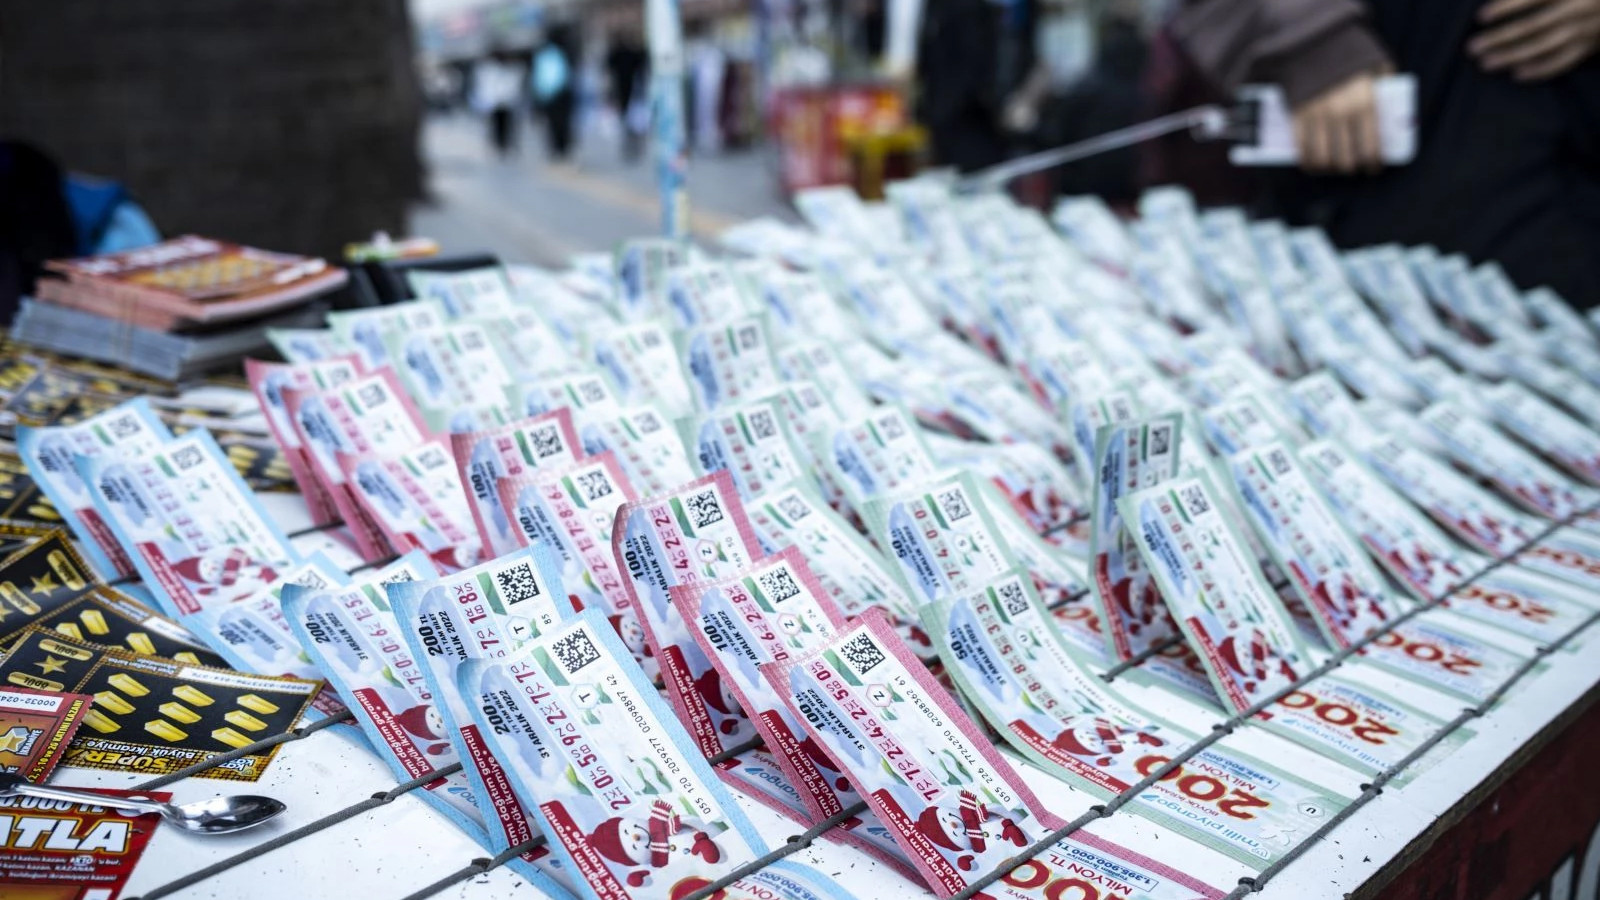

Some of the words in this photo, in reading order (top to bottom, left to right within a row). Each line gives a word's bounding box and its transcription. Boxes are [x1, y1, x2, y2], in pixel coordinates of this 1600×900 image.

[519, 514, 540, 540] 100
[654, 513, 671, 528] 2
[623, 538, 634, 551] TL
[638, 533, 655, 558] 2022
[664, 536, 680, 550] 2
[701, 547, 711, 556] Z
[889, 538, 908, 559] 50
[624, 551, 646, 580] 100
[648, 556, 670, 591] ARALIK
[345, 596, 363, 611] 5
[457, 589, 478, 607] 8
[731, 591, 747, 605] 8
[325, 610, 342, 629] 2022
[417, 613, 428, 624] TL
[437, 609, 456, 635] 2022
[513, 622, 526, 634] T
[539, 612, 552, 626] 85
[701, 613, 711, 623] TL
[717, 608, 737, 631] 2022
[745, 610, 761, 624] 2
[783, 619, 794, 629] Z
[304, 617, 330, 646] 200
[338, 626, 361, 652] ARALIK
[369, 626, 386, 640] 6
[416, 621, 444, 658] 200
[436, 628, 449, 646] TAM
[479, 633, 500, 650] 7
[703, 623, 728, 653] 100
[961, 622, 981, 645] 2022
[355, 648, 368, 661] 31
[731, 627, 758, 662] ARALIK
[948, 638, 969, 661] 50
[974, 643, 1000, 674] ARALIK
[1013, 662, 1027, 675] 8
[514, 665, 536, 684] 7
[605, 673, 618, 687] 42
[662, 648, 689, 694] garantili
[815, 667, 832, 684] 0
[893, 674, 906, 687] 61
[22, 676, 49, 690] ÖDÜL
[832, 686, 850, 702] 5
[1027, 680, 1042, 694] 8
[354, 688, 385, 726] garantili
[480, 691, 491, 703] TL
[488, 690, 504, 709] BİLET
[498, 687, 519, 712] 2022
[530, 687, 551, 705] 7
[578, 689, 592, 702] T
[682, 674, 707, 720] ikramiye
[793, 691, 804, 703] TL
[799, 689, 817, 708] BİLET
[806, 685, 829, 710] 2022
[872, 690, 884, 701] Z
[1043, 697, 1057, 711] 5
[482, 702, 510, 737] 200
[500, 708, 513, 724] TAM
[545, 707, 567, 726] 2
[616, 688, 650, 733] 02098897
[682, 694, 706, 736] dağıtım
[798, 701, 826, 732] 100
[813, 705, 834, 729] YARIM
[850, 705, 868, 721] 2
[905, 688, 943, 728] 62088362
[1278, 690, 1400, 745] 200
[52, 719, 71, 743] KATINI
[64, 697, 83, 722] KAZAN!
[380, 708, 410, 747] ikramiye
[514, 711, 542, 747] ARALIK
[826, 707, 856, 741] ARALIK
[380, 723, 407, 759] dağıtım
[561, 729, 582, 747] 9
[702, 721, 722, 754] büyük
[760, 712, 794, 756] garantili
[853, 737, 865, 751] 31
[867, 724, 885, 742] 4
[1009, 722, 1048, 754] garantili
[151, 746, 195, 760] Büyük
[460, 726, 491, 776] garantili
[535, 744, 550, 760] 31
[648, 735, 680, 774] 2059277
[786, 735, 820, 779] ikramiye
[885, 744, 904, 761] 2
[942, 728, 976, 764] 7724250
[1038, 737, 1079, 766] ikramiye
[87, 748, 167, 772] SÜPER
[406, 745, 430, 772] büyük
[576, 750, 597, 769] 5
[1046, 750, 1084, 776] dağıtım
[485, 755, 514, 804] ikramiye
[592, 772, 614, 791] 0
[789, 754, 820, 795] dağıtım
[904, 764, 922, 781] 7
[975, 766, 993, 784] 226
[1080, 761, 1109, 781] büyük
[1084, 771, 1121, 794] Tamamı
[1197, 761, 1256, 792] MİLYON
[678, 775, 695, 792] 120
[816, 778, 842, 812] büyük
[922, 784, 941, 802] 7
[993, 785, 1012, 803] 055
[1135, 755, 1271, 820] 200
[484, 776, 511, 822] dağıtım
[609, 793, 631, 812] 2
[694, 796, 711, 815] 055
[1186, 798, 1219, 817] BÜYÜK
[1305, 805, 1317, 815] U
[509, 804, 532, 842] büyük
[872, 792, 911, 837] garantili
[1153, 795, 1224, 833] piyango
[541, 804, 579, 851] garantili
[902, 815, 941, 862] ikramiye
[1221, 825, 1259, 849] milli
[571, 828, 608, 877] ikramiye
[908, 836, 945, 878] dağıtım
[1046, 853, 1066, 868] TL
[572, 851, 607, 895] dağıtım
[1071, 847, 1151, 884] 1.395.900.000
[1065, 860, 1133, 896] MİLYON
